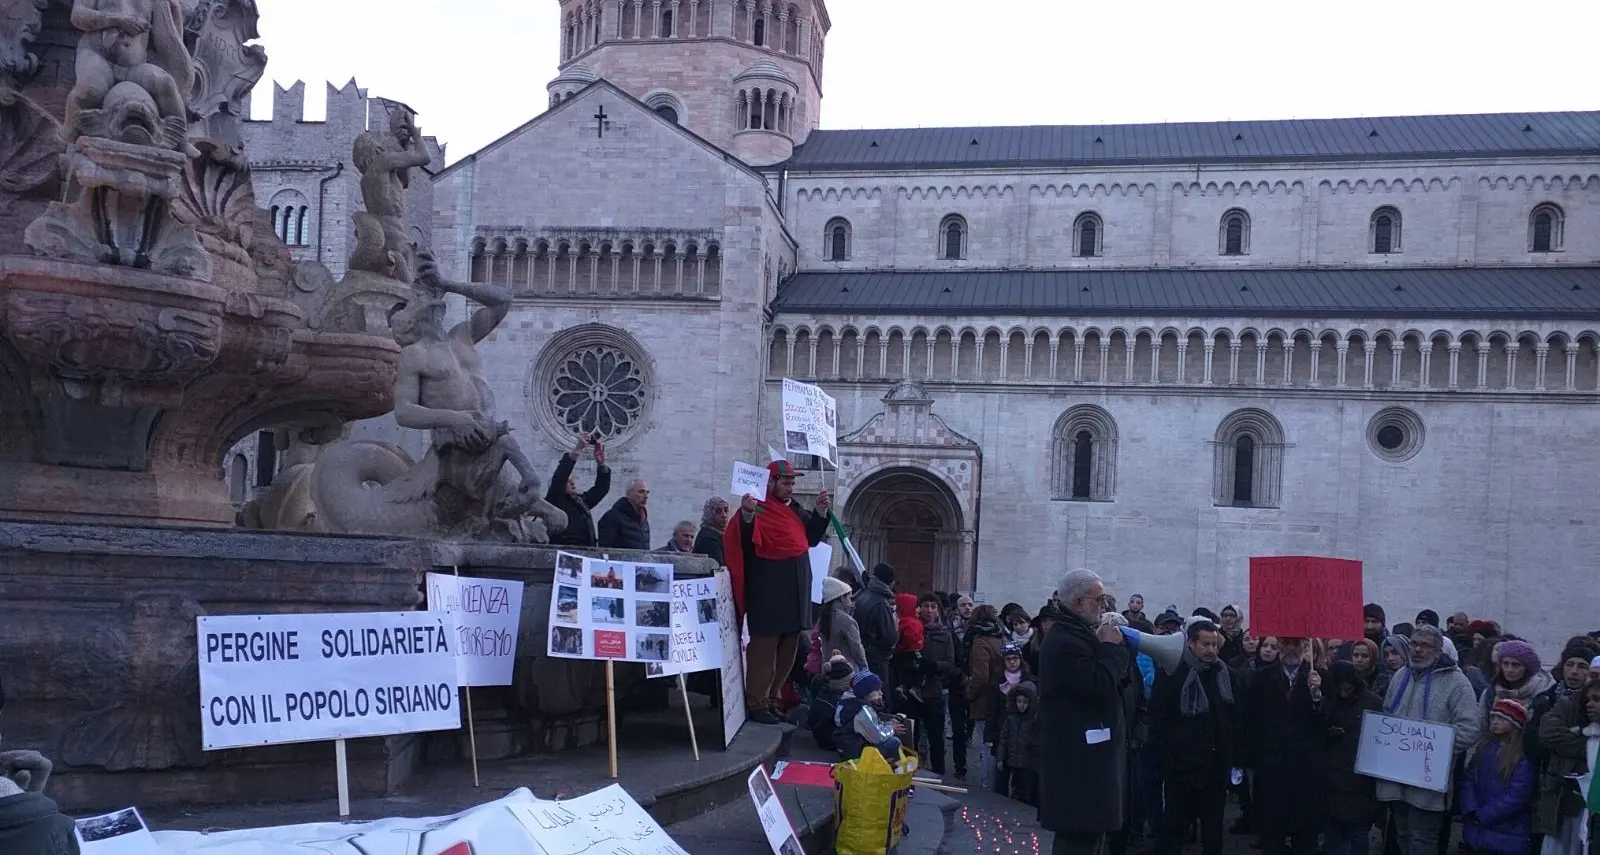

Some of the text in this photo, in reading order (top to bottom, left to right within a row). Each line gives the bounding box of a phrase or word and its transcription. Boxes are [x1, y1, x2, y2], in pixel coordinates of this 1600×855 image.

[207, 618, 448, 663] PERGINE SOLIDARIETÀ
[210, 683, 451, 726] CON IL POPOLO SIRIANO
[1379, 717, 1436, 740] SOLIDALI
[1398, 738, 1434, 752] SIRIA
